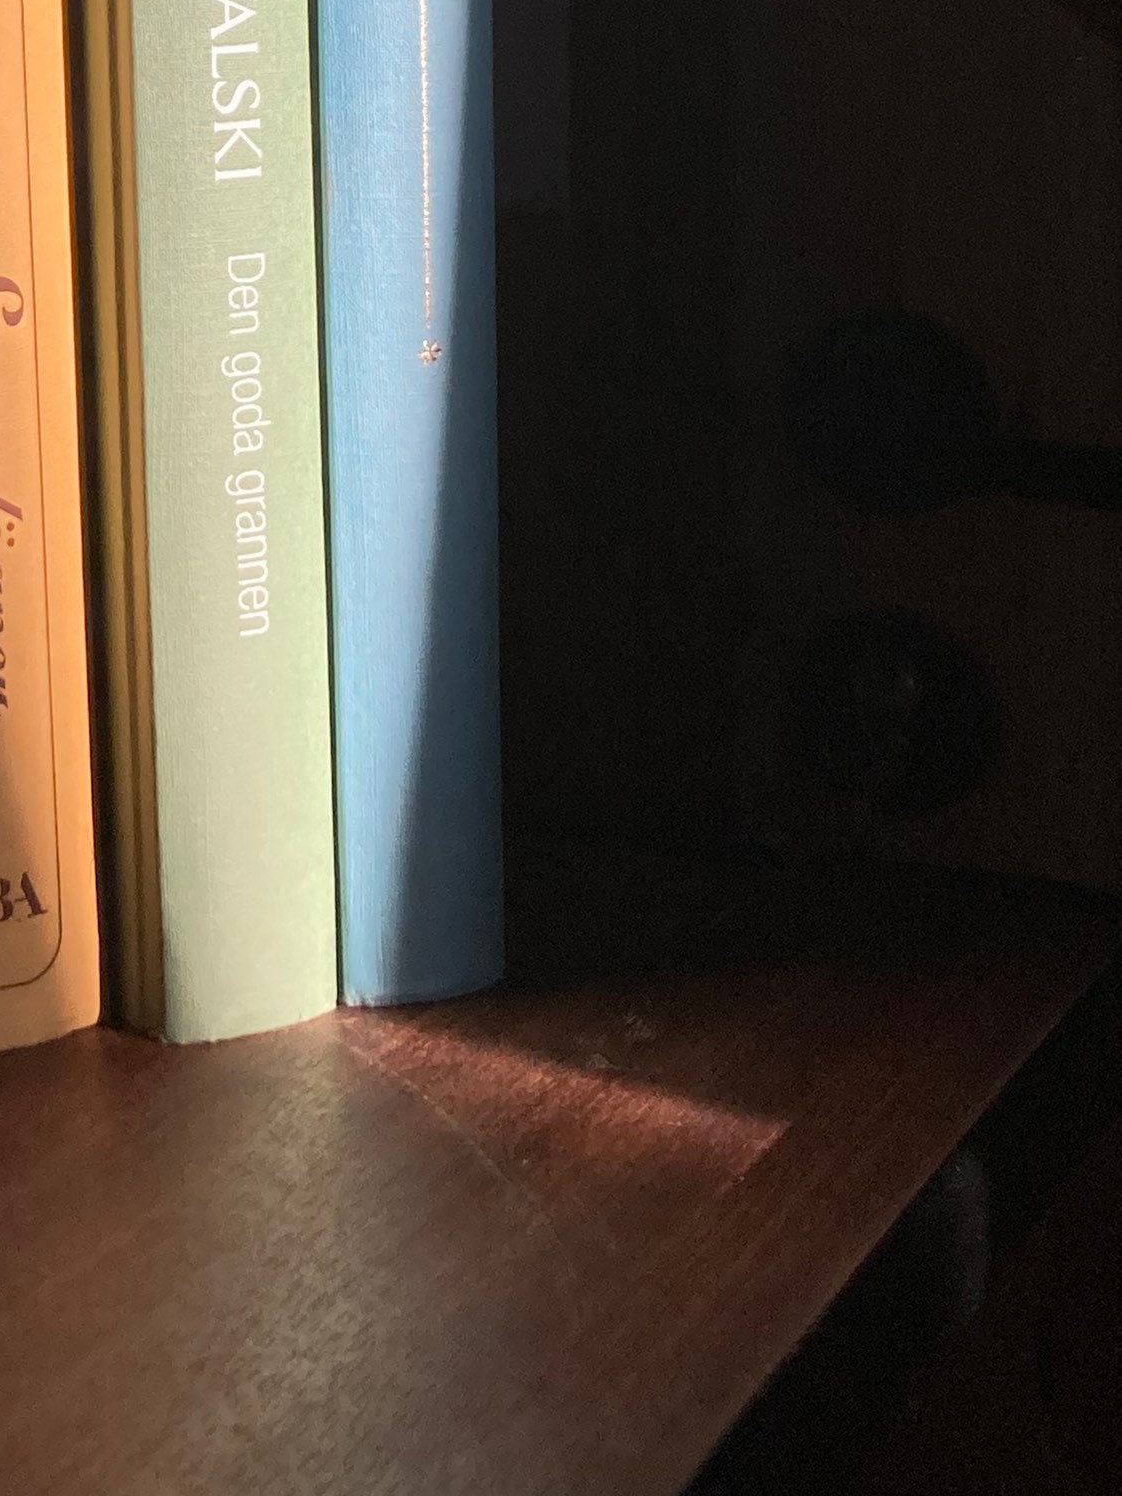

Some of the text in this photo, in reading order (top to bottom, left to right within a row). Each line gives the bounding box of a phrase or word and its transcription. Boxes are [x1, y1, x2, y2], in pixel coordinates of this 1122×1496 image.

[221, 251, 272, 640] Den goda grannen
